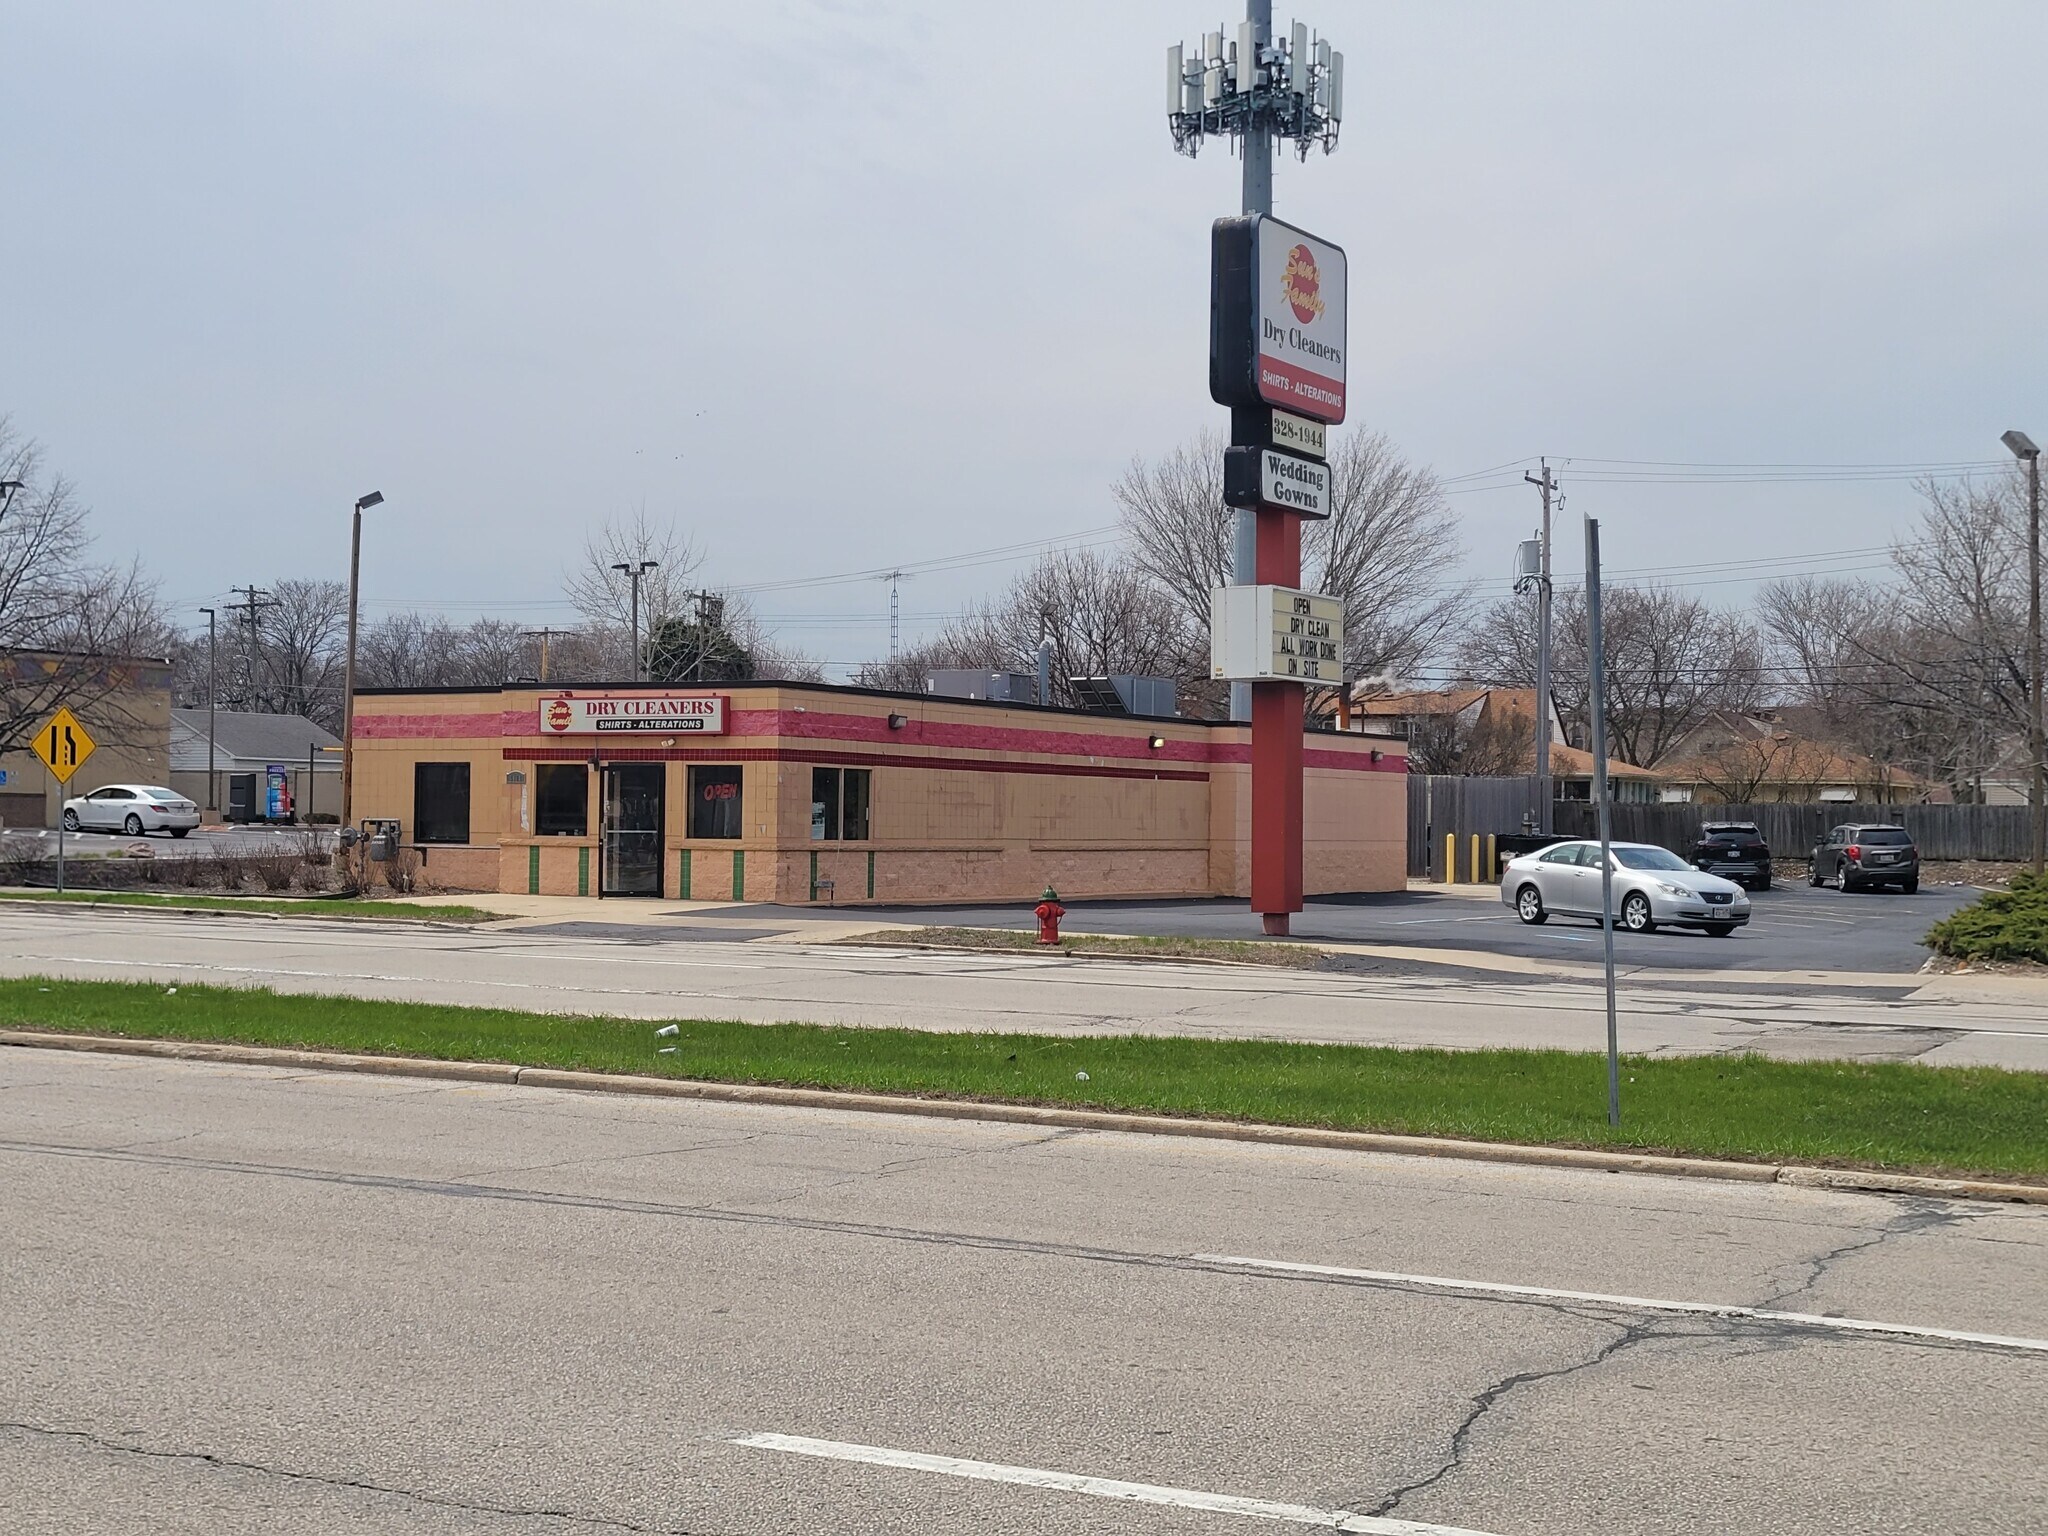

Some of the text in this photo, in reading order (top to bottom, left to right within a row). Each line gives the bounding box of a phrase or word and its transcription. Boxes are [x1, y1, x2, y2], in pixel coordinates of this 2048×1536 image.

[1264, 317, 1341, 364] Dry Cleaners
[1262, 370, 1290, 391] SHIRTS
[1294, 381, 1342, 407] ALTERATIONS
[1273, 417, 1324, 448] 328-1944
[1268, 455, 1324, 491] Wedding
[1273, 481, 1319, 509] Gowns
[1293, 597, 1311, 615] OPEN
[1291, 617, 1330, 638] DRY CLEAN
[1281, 636, 1337, 661] ALL WORK DONE
[1288, 657, 1319, 677] ON SITE
[586, 700, 715, 716] DRY CLEANERS
[598, 720, 632, 729] SHIRTS
[638, 719, 701, 729] ALTERATIONS
[704, 783, 738, 801] OPEN
